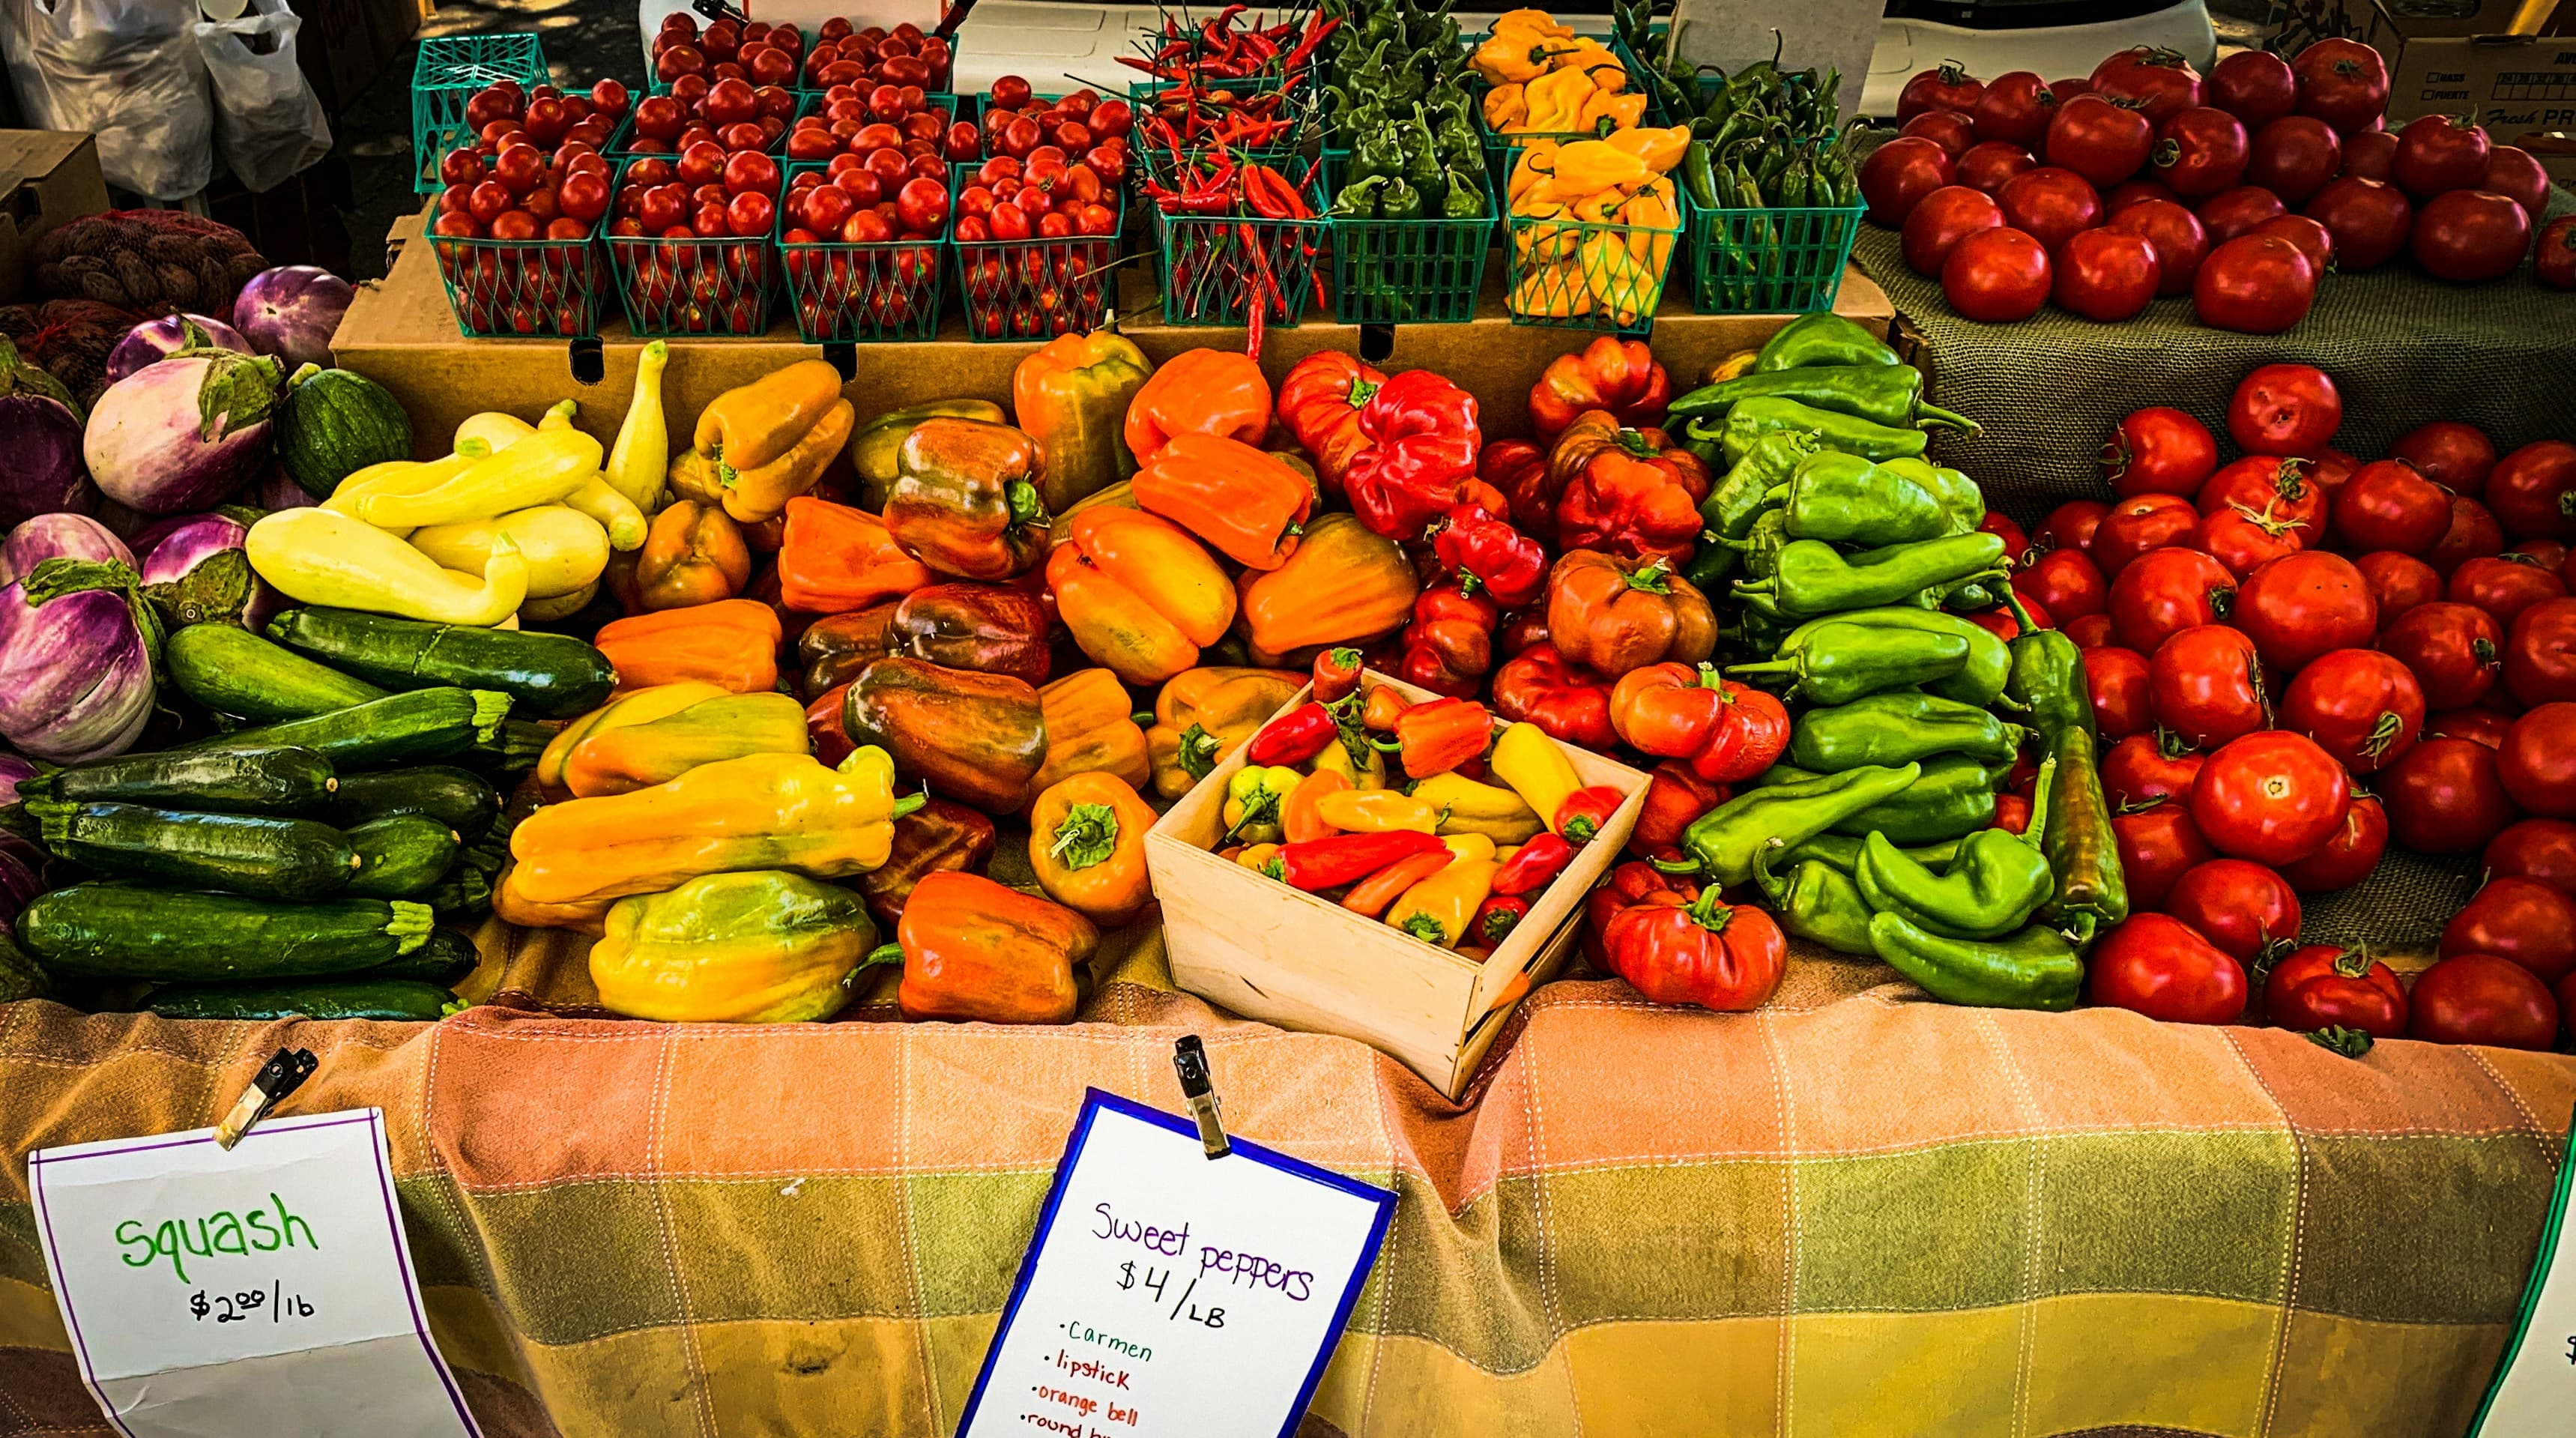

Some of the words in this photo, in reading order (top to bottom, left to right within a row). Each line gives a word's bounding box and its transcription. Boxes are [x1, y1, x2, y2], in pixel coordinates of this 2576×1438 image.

[2434, 91, 2470, 100] FUERTE
[2485, 109, 2539, 127] Fresh
[2542, 109, 2576, 125] PR
[1092, 1203, 1189, 1256] Sweet
[1200, 1247, 1313, 1301] peppers
[1038, 1386, 1097, 1417] orange
[1107, 1401, 1137, 1427] bell
[1028, 1415, 1082, 1438] round
